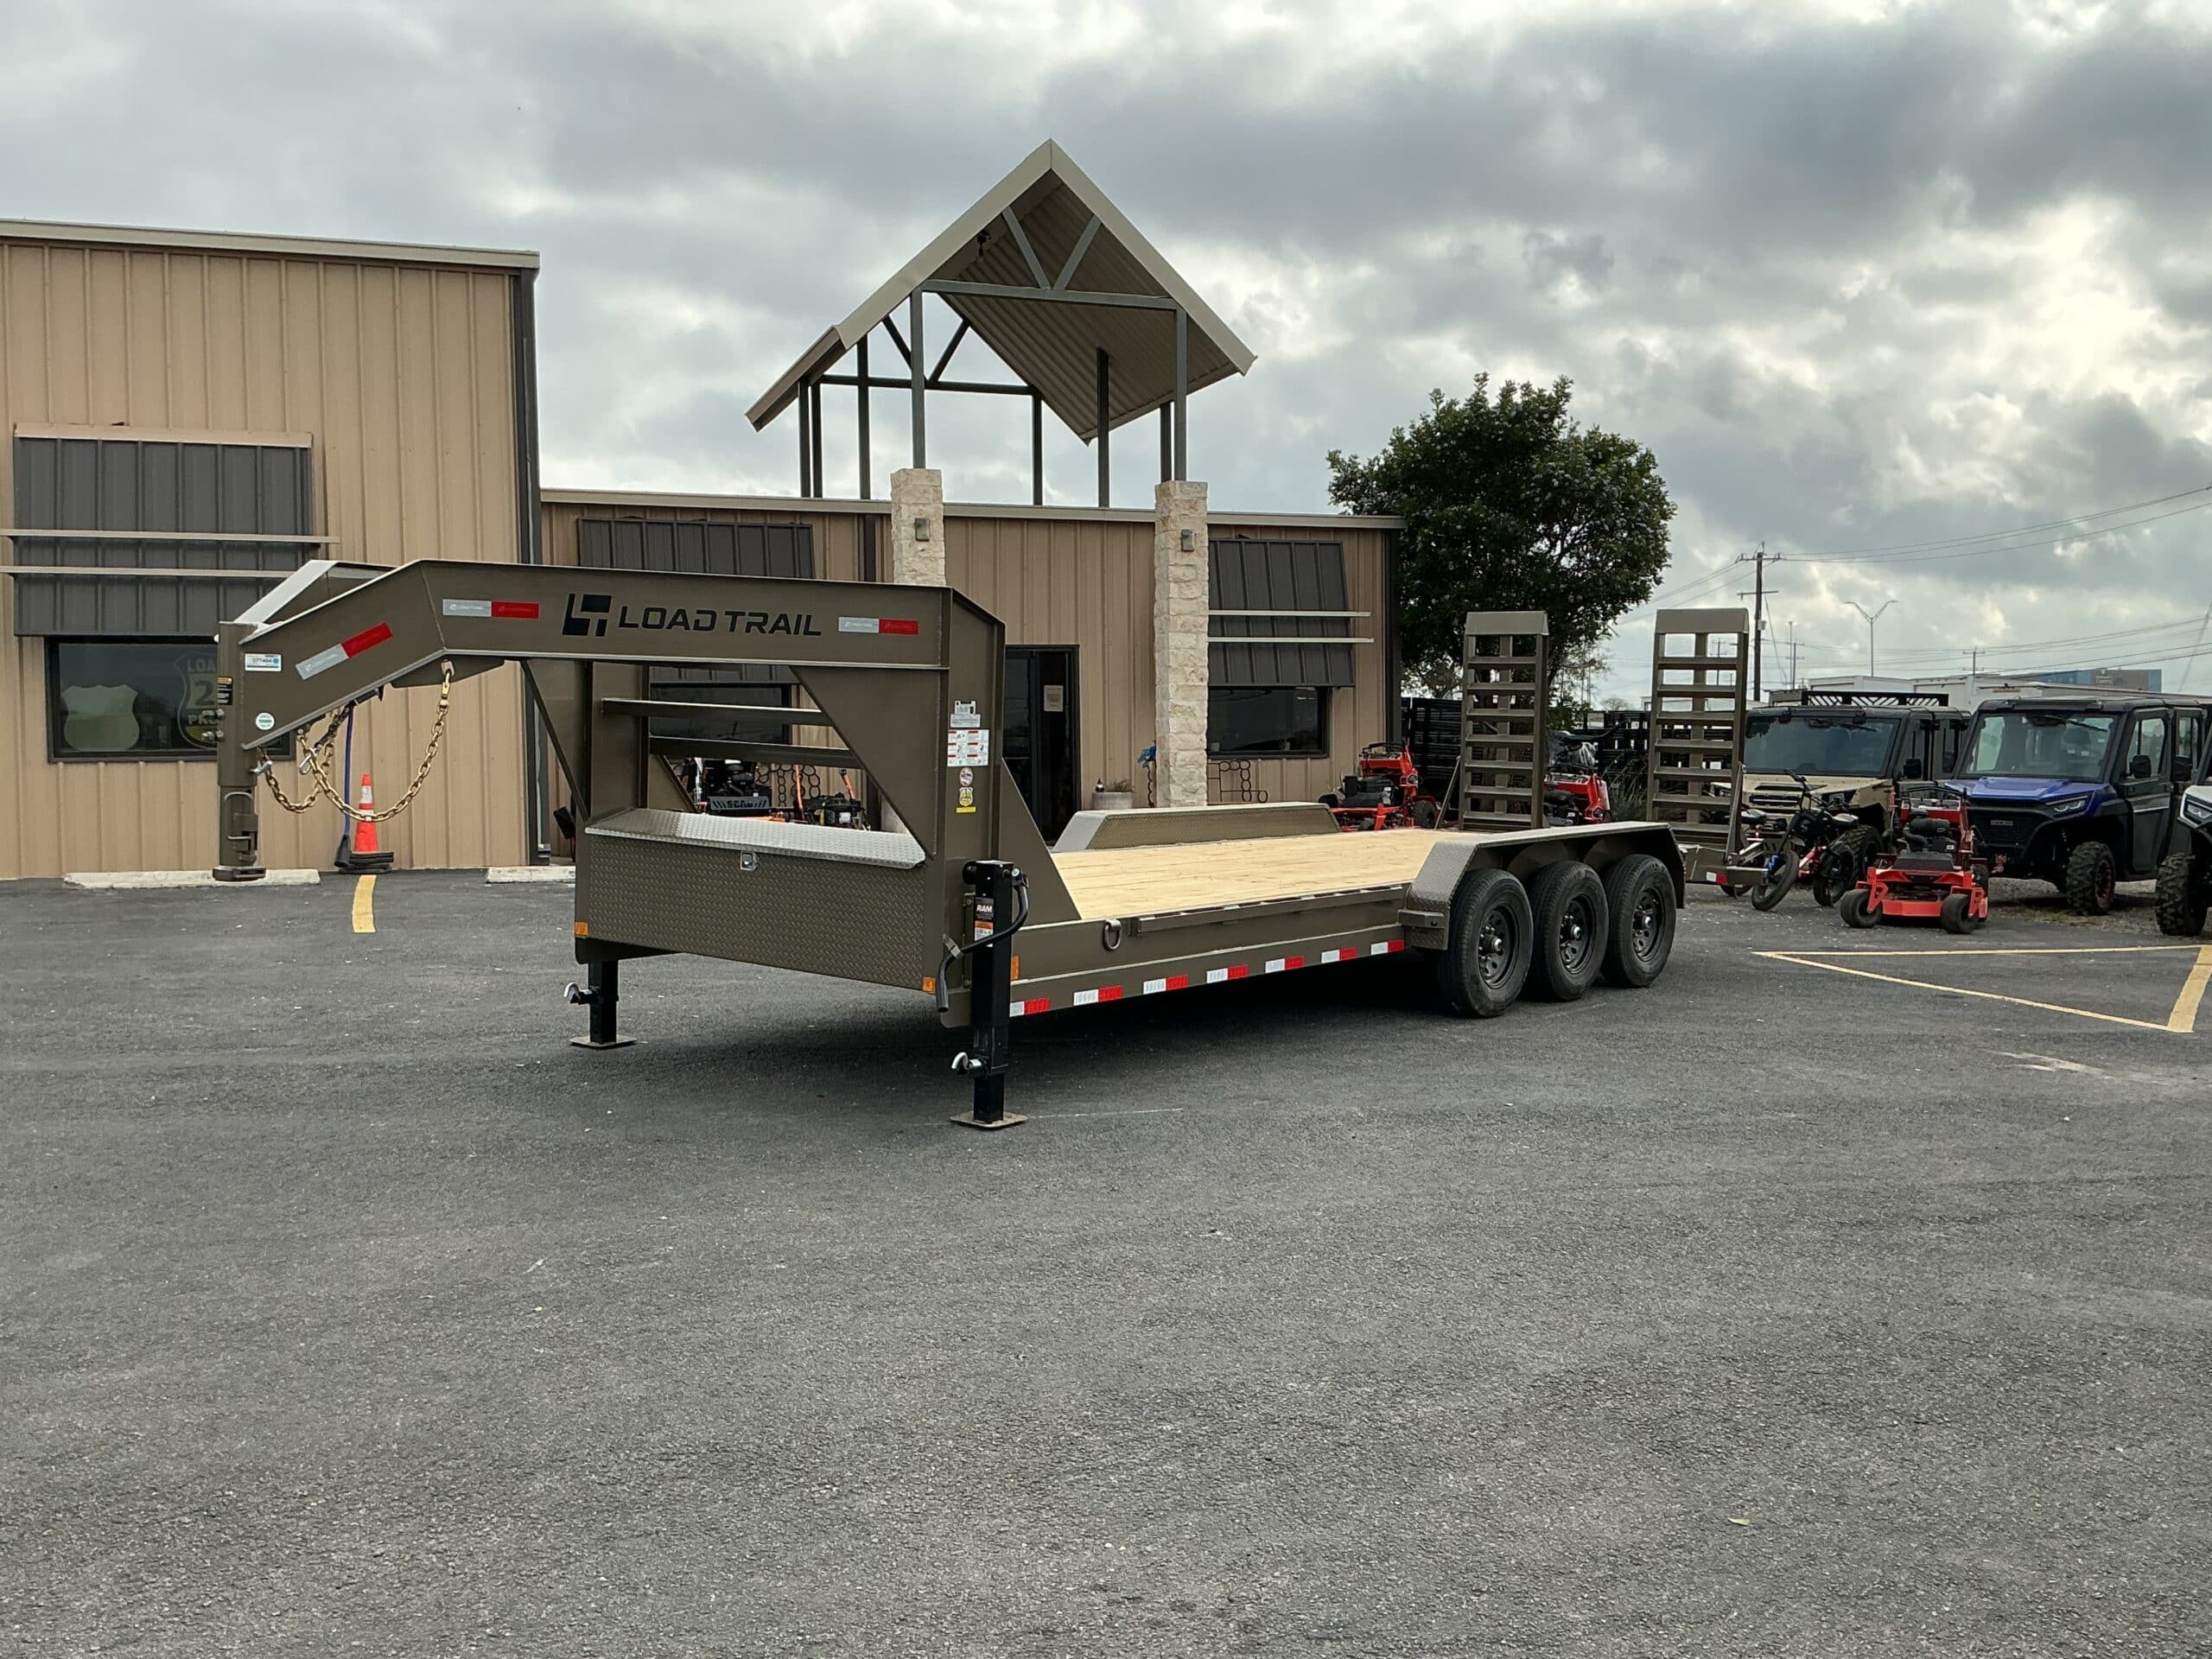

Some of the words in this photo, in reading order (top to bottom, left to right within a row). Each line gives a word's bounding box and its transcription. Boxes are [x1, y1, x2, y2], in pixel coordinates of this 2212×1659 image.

[618, 606, 717, 632] LOAD
[724, 611, 823, 637] TRAIL
[187, 658, 217, 672] LOA
[976, 904, 993, 913] RAM
